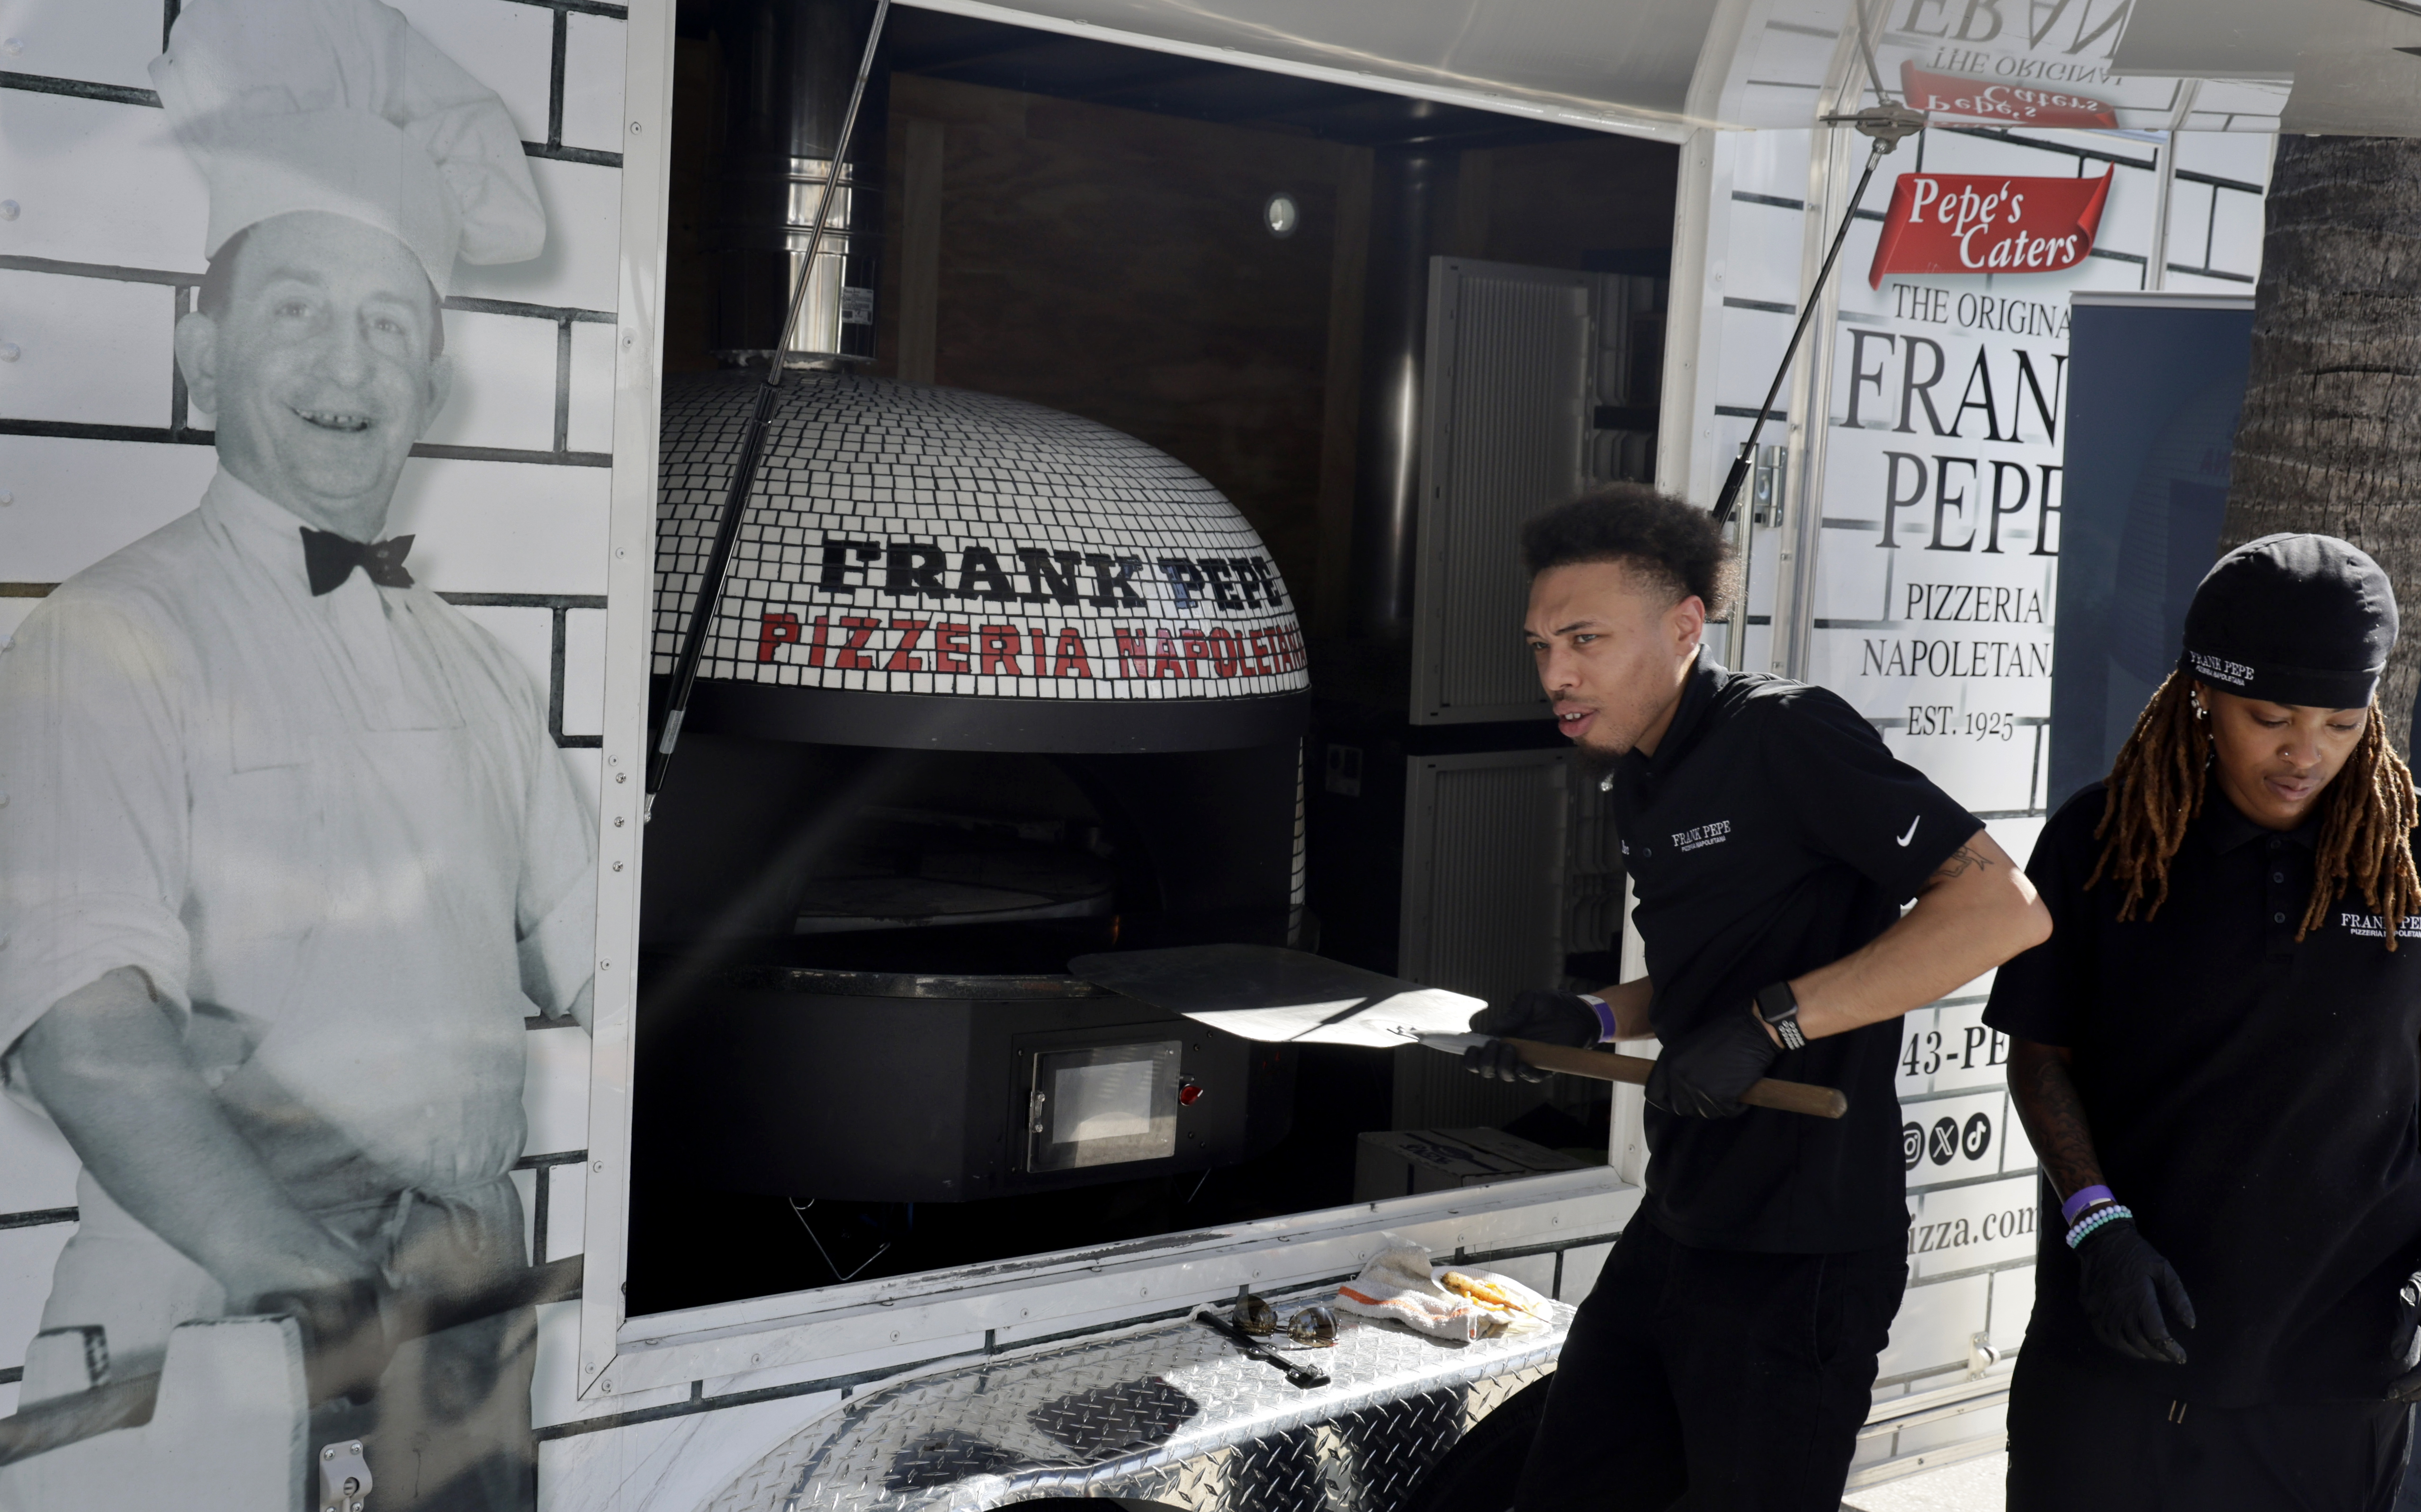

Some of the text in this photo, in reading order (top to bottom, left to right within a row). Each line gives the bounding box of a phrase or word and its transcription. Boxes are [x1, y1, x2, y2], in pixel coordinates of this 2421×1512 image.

[1909, 177, 2024, 237] Pepe's
[1959, 224, 2078, 269] Caters
[1892, 283, 1950, 324] THE
[1838, 327, 2069, 448] FRAN
[819, 540, 1283, 610] FRANK PEPE
[1904, 583, 2044, 624] PIZZERIA
[759, 612, 1092, 678] PIZZERIA
[1860, 638, 2054, 678] NAPOLETAN
[2189, 651, 2254, 680] FRANK PEPE
[1906, 705, 2014, 742] EST. 1925
[1671, 820, 1731, 847] FRANK PEPE
[2341, 913, 2421, 930] FRAN PE
[2350, 929, 2383, 937] PIZZERIA
